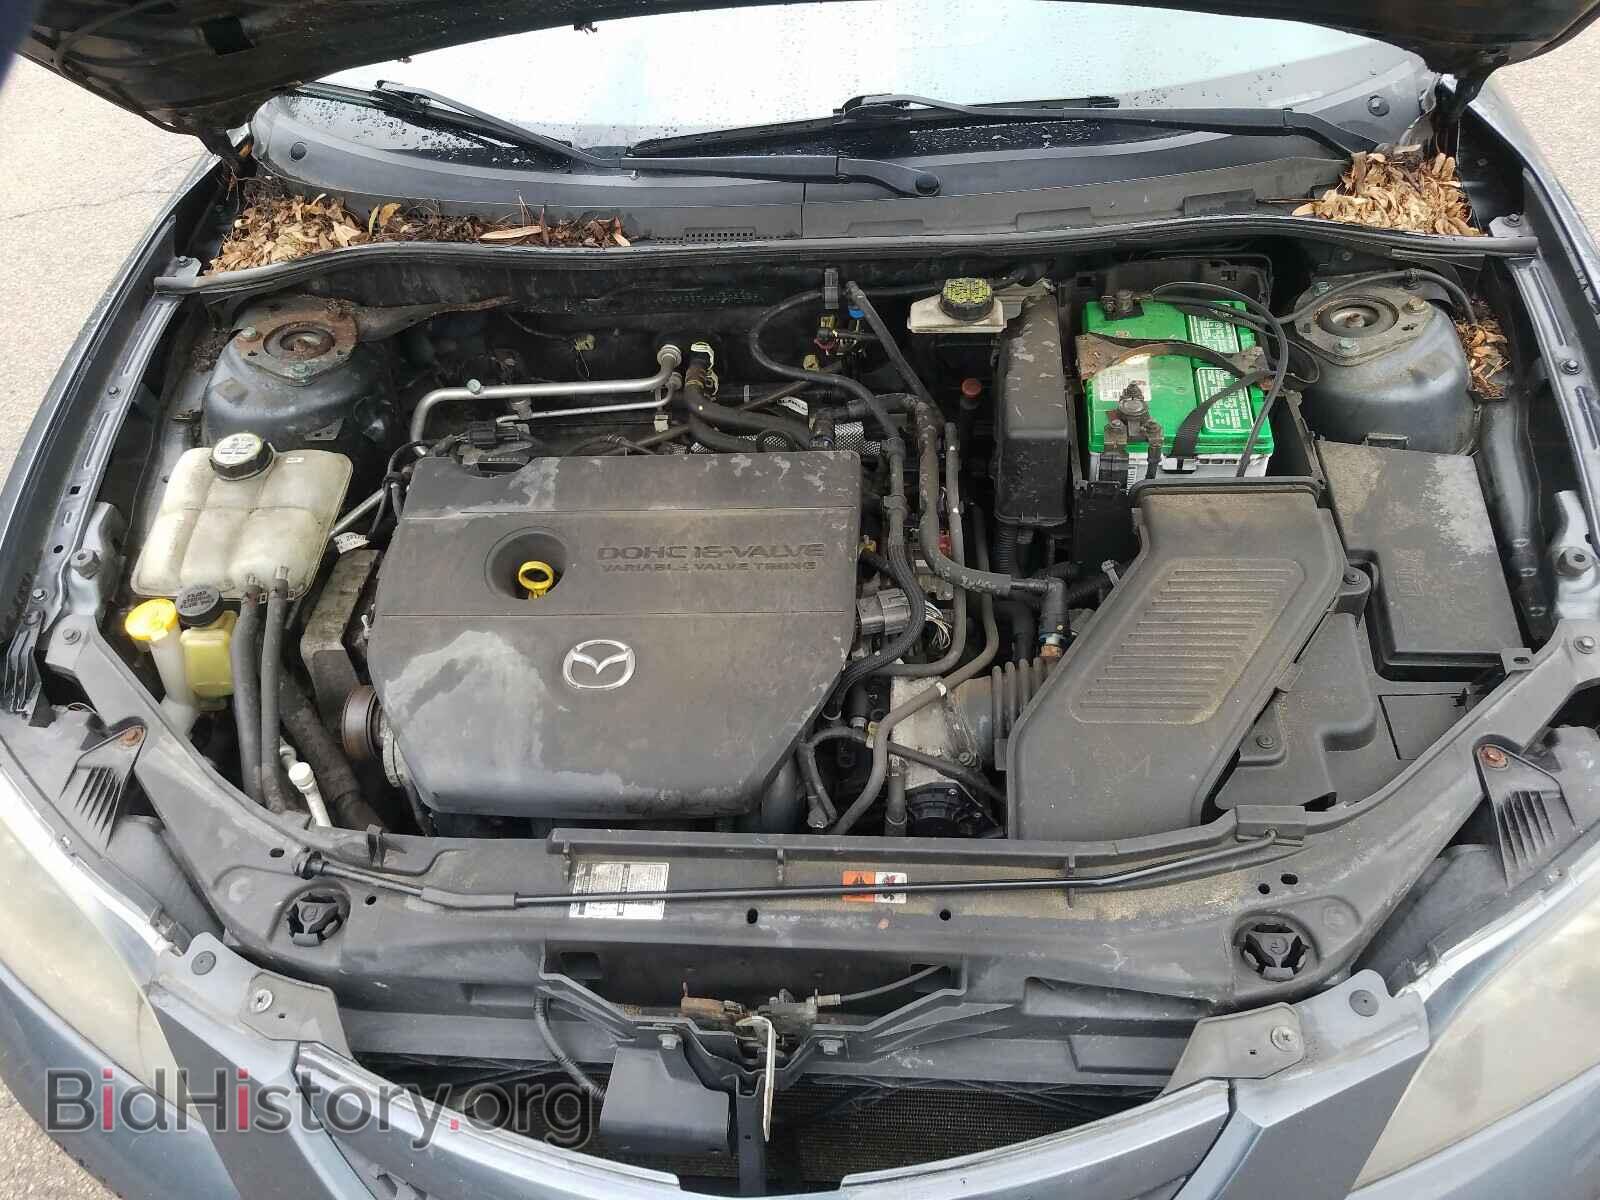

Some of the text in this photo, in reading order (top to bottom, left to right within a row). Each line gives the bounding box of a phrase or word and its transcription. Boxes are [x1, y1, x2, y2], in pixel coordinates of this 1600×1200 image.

[598, 543, 824, 560] DOHC 16-VALVE
[694, 562, 750, 571] VALVE
